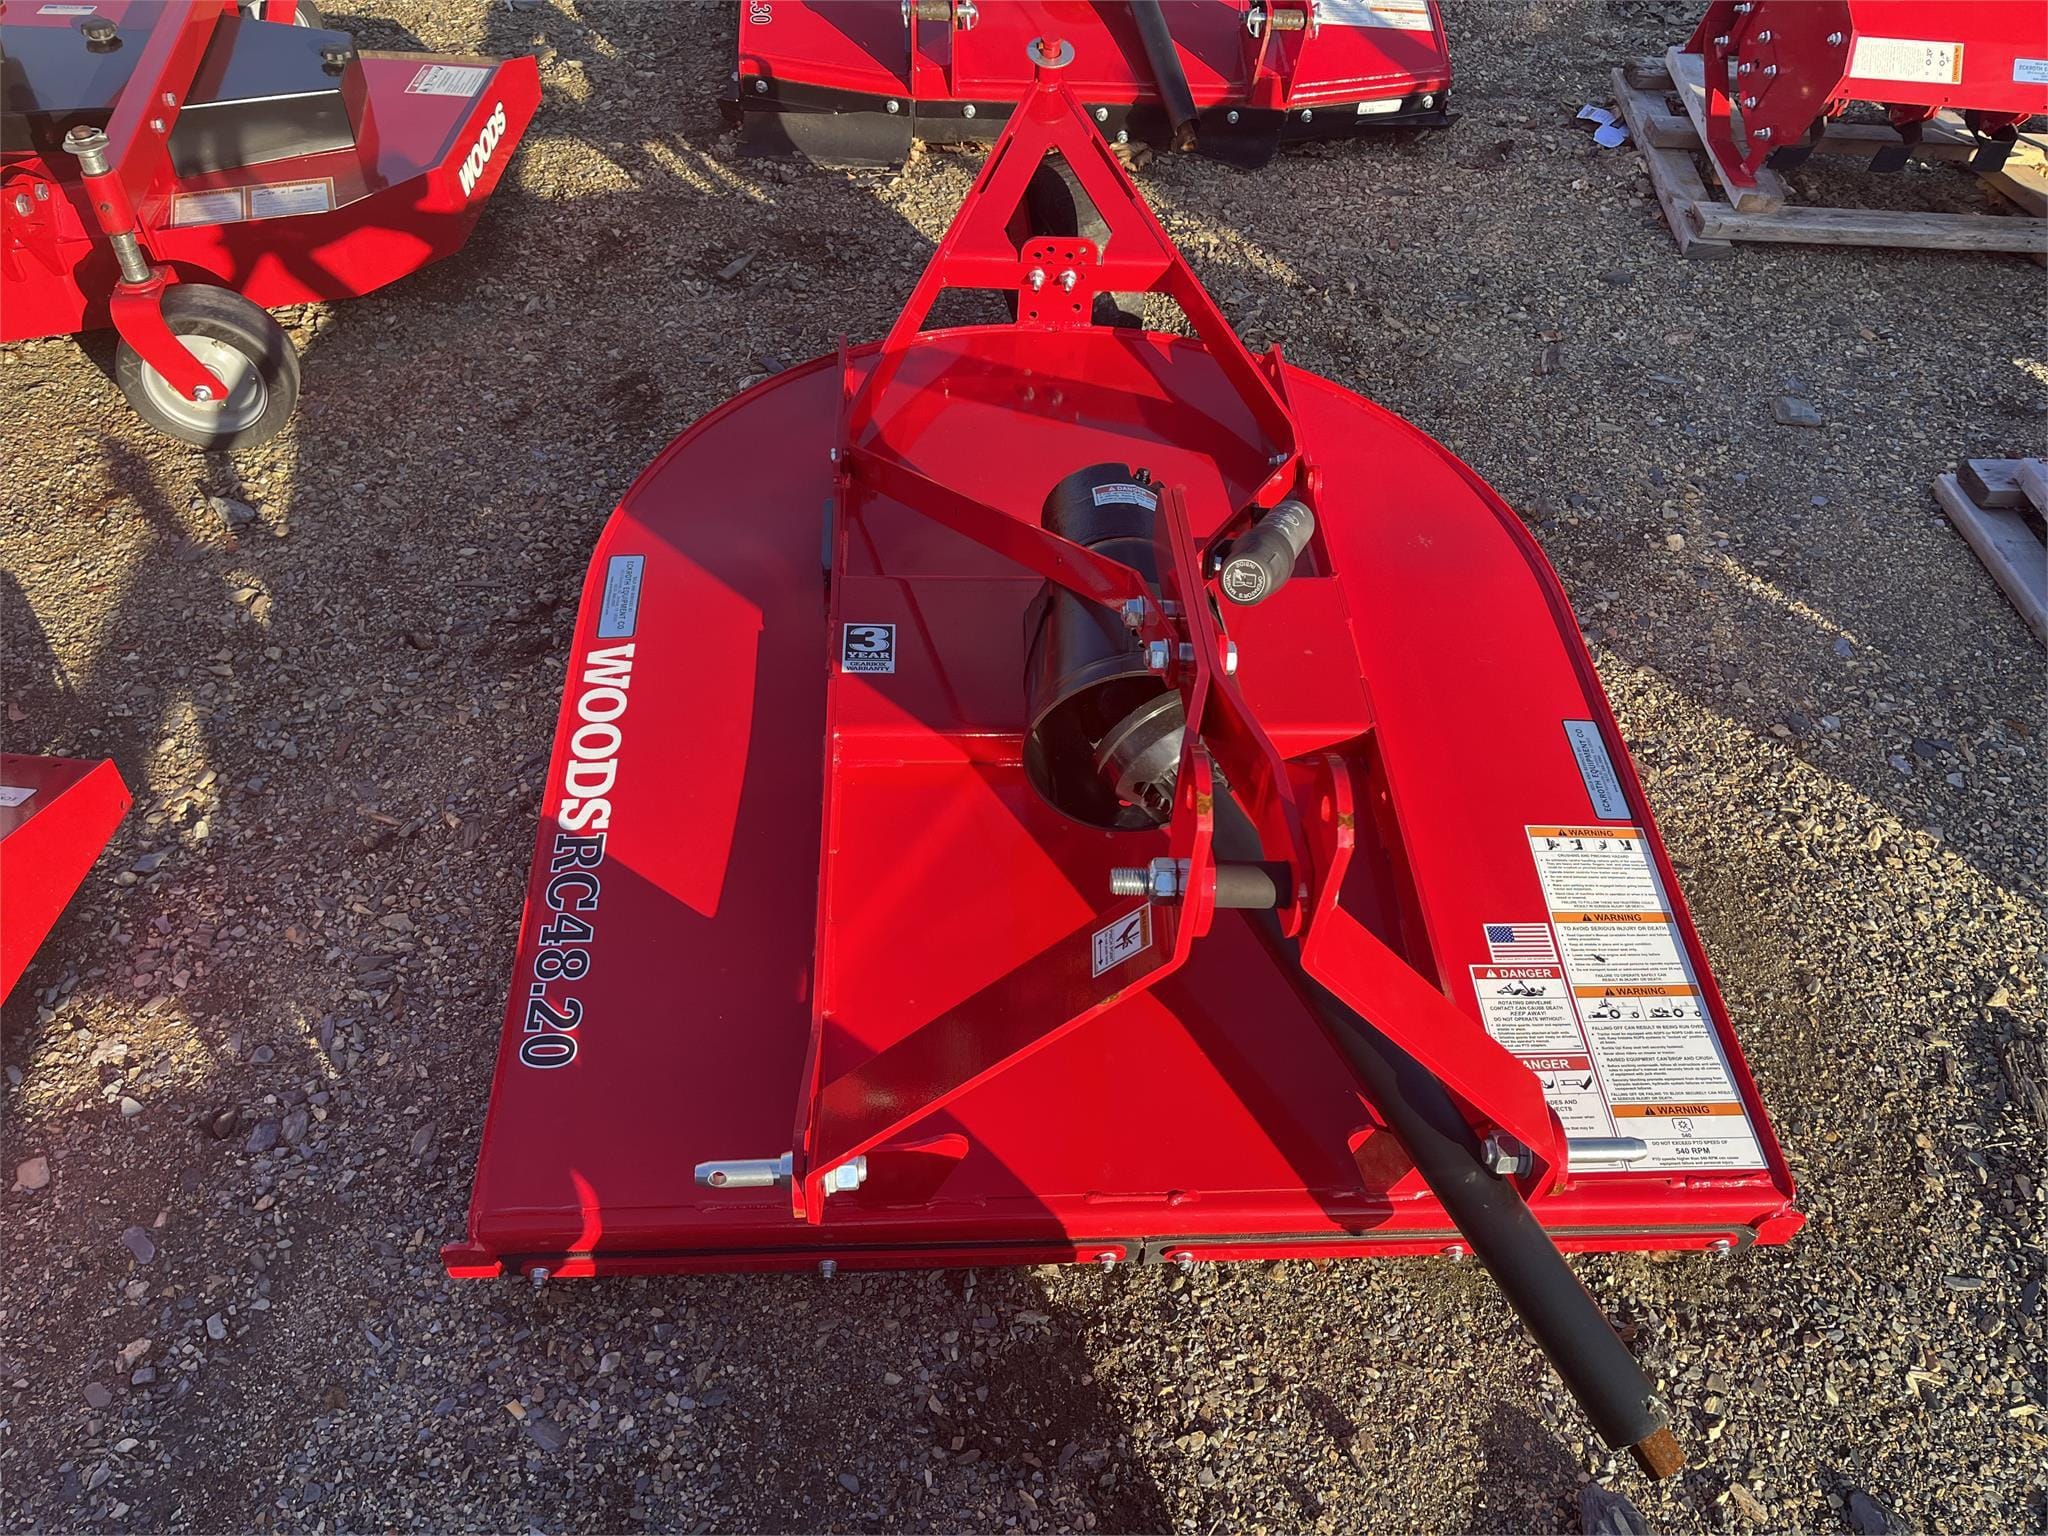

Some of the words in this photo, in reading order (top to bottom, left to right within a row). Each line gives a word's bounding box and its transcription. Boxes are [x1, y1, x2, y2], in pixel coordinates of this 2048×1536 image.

[458, 101, 506, 198] WOODS
[624, 560, 634, 586] ECKROTH
[620, 586, 630, 620] EQUIPMENT
[616, 621, 625, 630] CO
[848, 626, 890, 652] 3
[558, 643, 635, 831] WOODS
[1576, 728, 1584, 738] CO
[1579, 740, 1599, 778] EQUIPMENT
[1594, 780, 1612, 812] ECKROTH
[519, 832, 608, 1069] RC48.20
[1500, 968, 1552, 978] DANGER
[1616, 987, 1666, 996] WARNING
[1523, 1059, 1570, 1070] ANGER
[1657, 1106, 1710, 1114] WARNING
